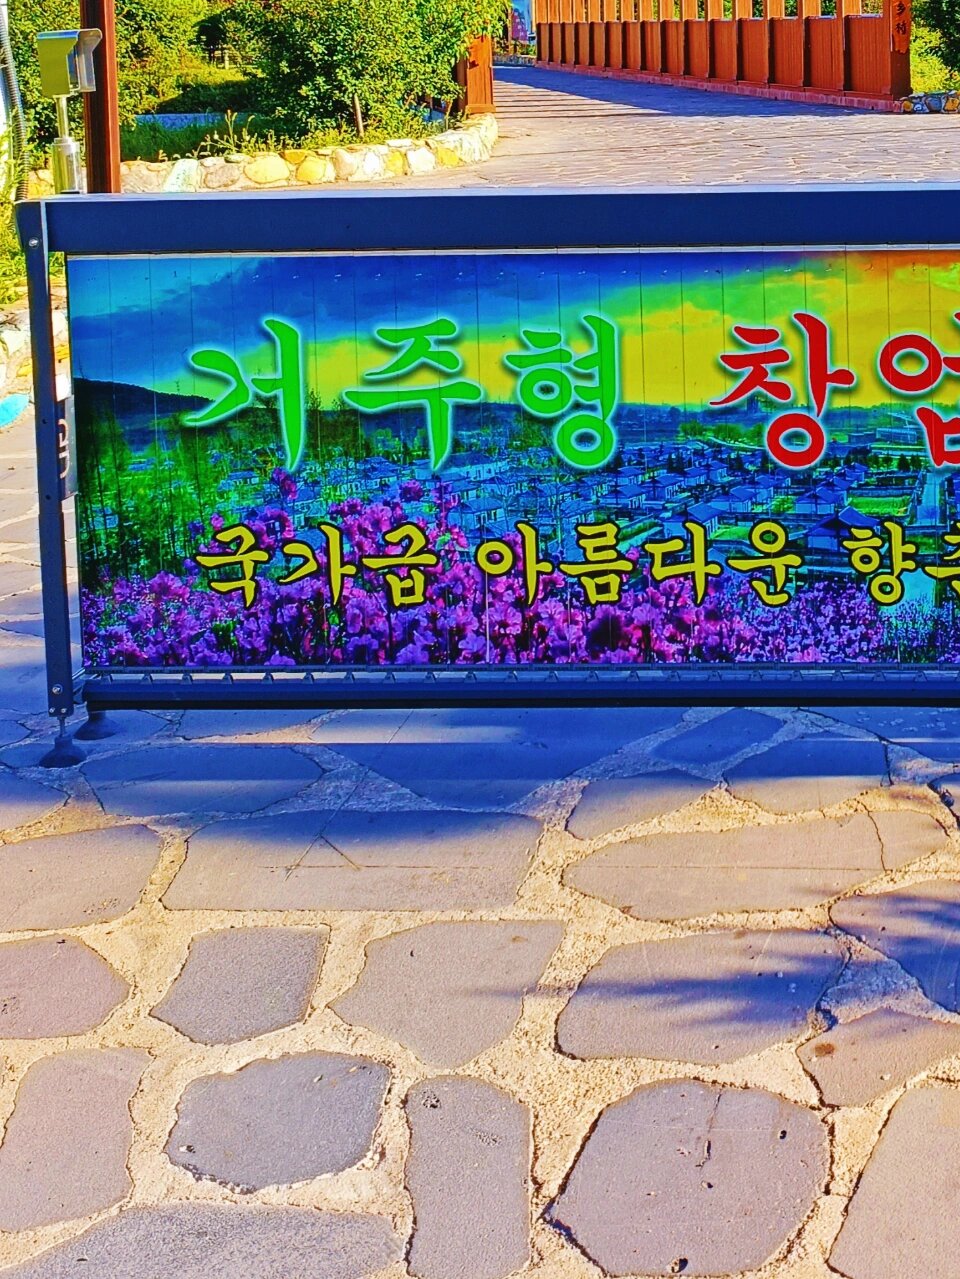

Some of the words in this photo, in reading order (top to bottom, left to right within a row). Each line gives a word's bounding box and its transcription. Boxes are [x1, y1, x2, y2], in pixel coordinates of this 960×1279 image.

[184, 314, 618, 471] 거주형
[195, 522, 438, 607] 국가급
[477, 522, 802, 605] 아름다운
